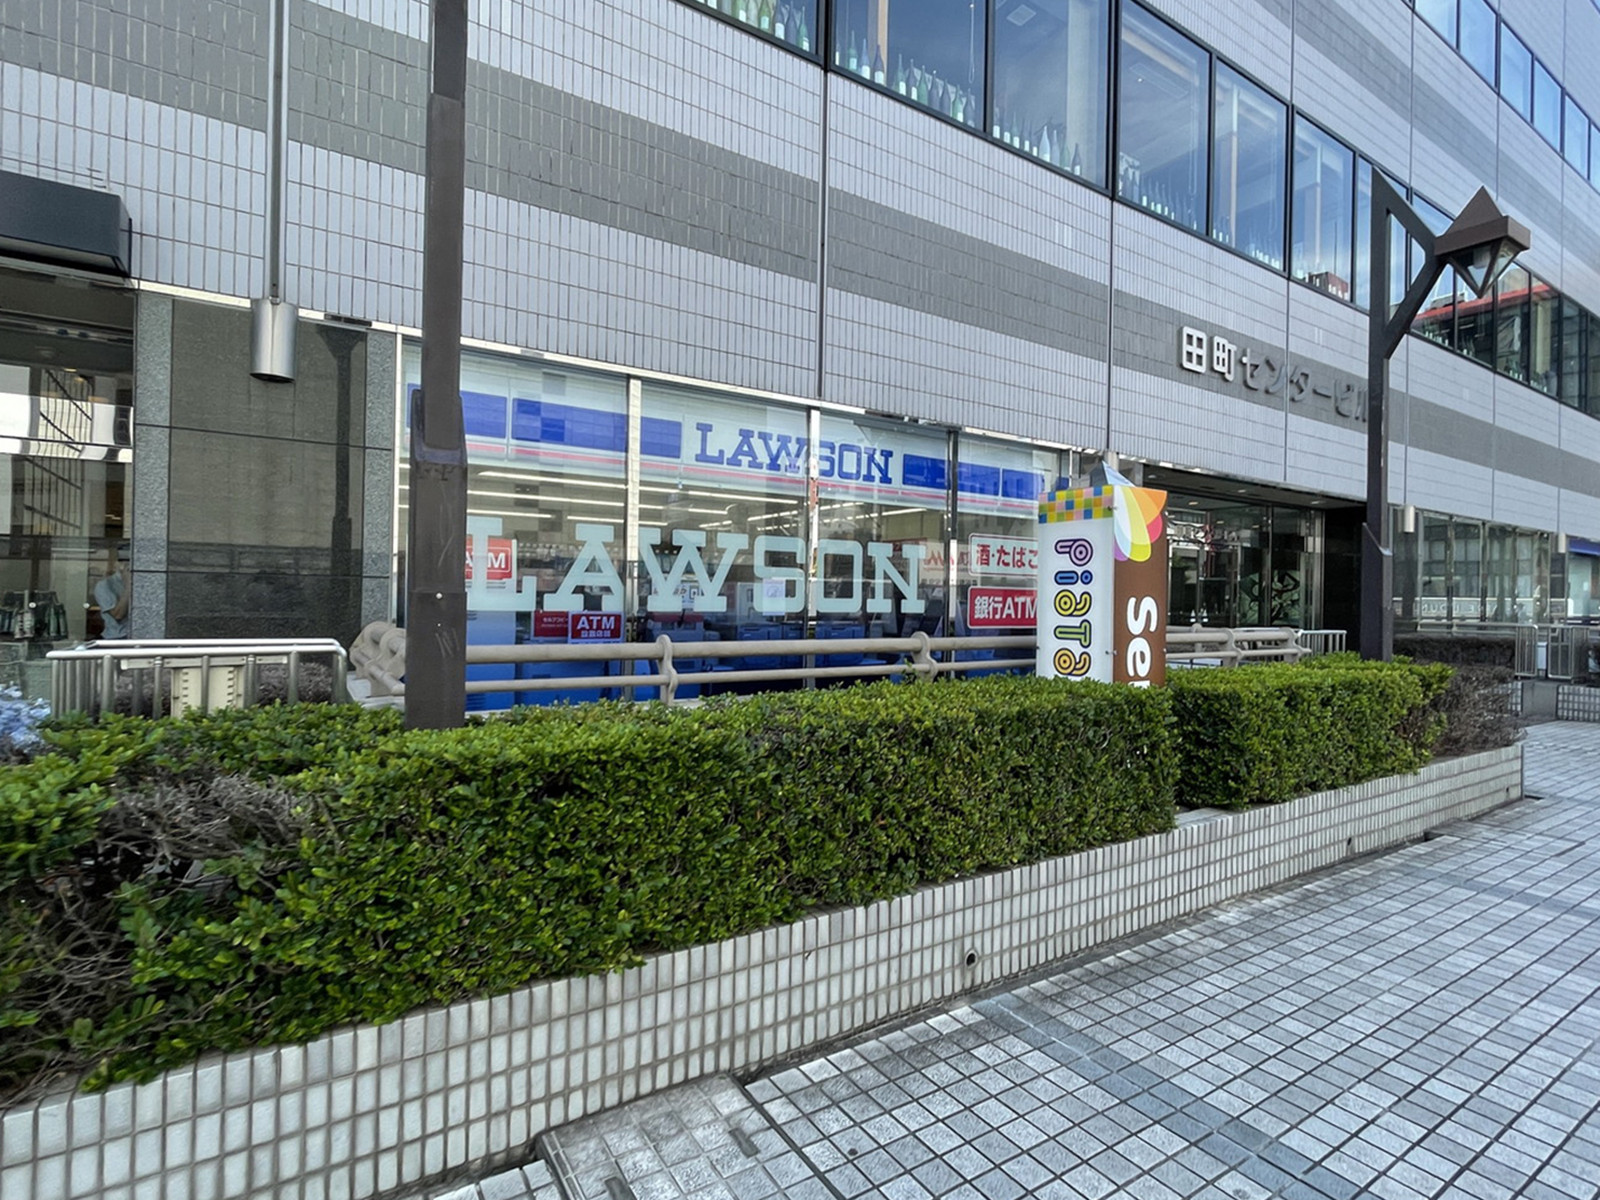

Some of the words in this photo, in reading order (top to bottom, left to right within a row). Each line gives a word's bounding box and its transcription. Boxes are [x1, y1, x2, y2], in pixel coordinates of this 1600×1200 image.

[695, 422, 893, 484] LAWSON
[465, 515, 926, 614] LAWSON
[576, 616, 615, 630] ATM
[1126, 596, 1158, 688] Se
